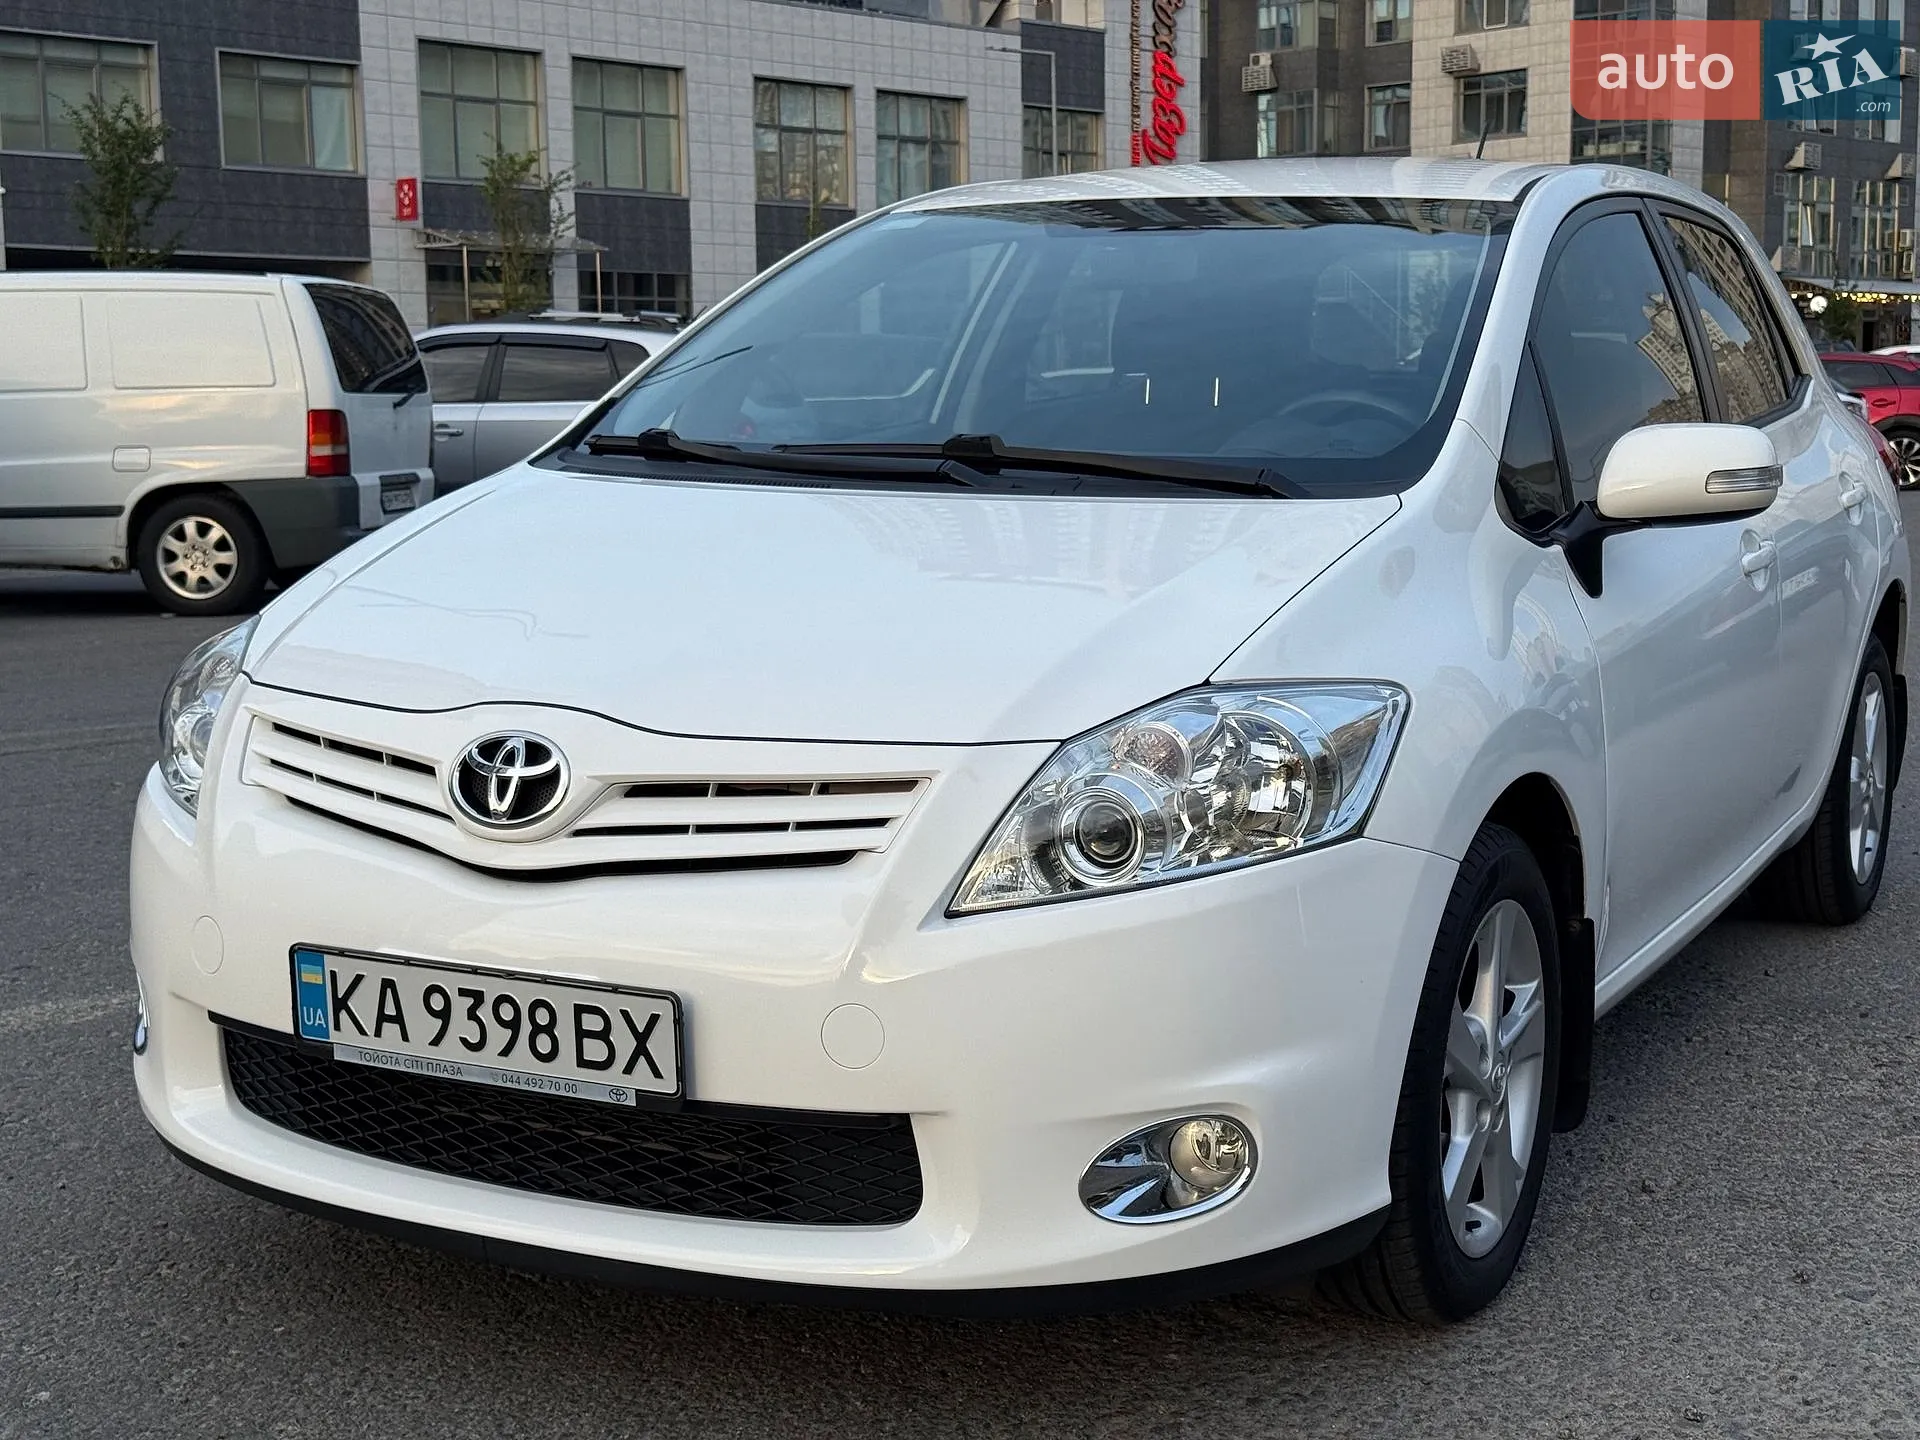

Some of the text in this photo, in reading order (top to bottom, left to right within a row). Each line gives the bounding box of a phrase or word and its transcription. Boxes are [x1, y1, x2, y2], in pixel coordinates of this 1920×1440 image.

[304, 1006, 327, 1029] UA
[329, 969, 664, 1080] KA 9398 BX
[358, 1050, 402, 1067] ТОЙОТА
[426, 1061, 463, 1078] ПЛАЗА
[501, 1073, 578, 1095] 044 492 70 00
